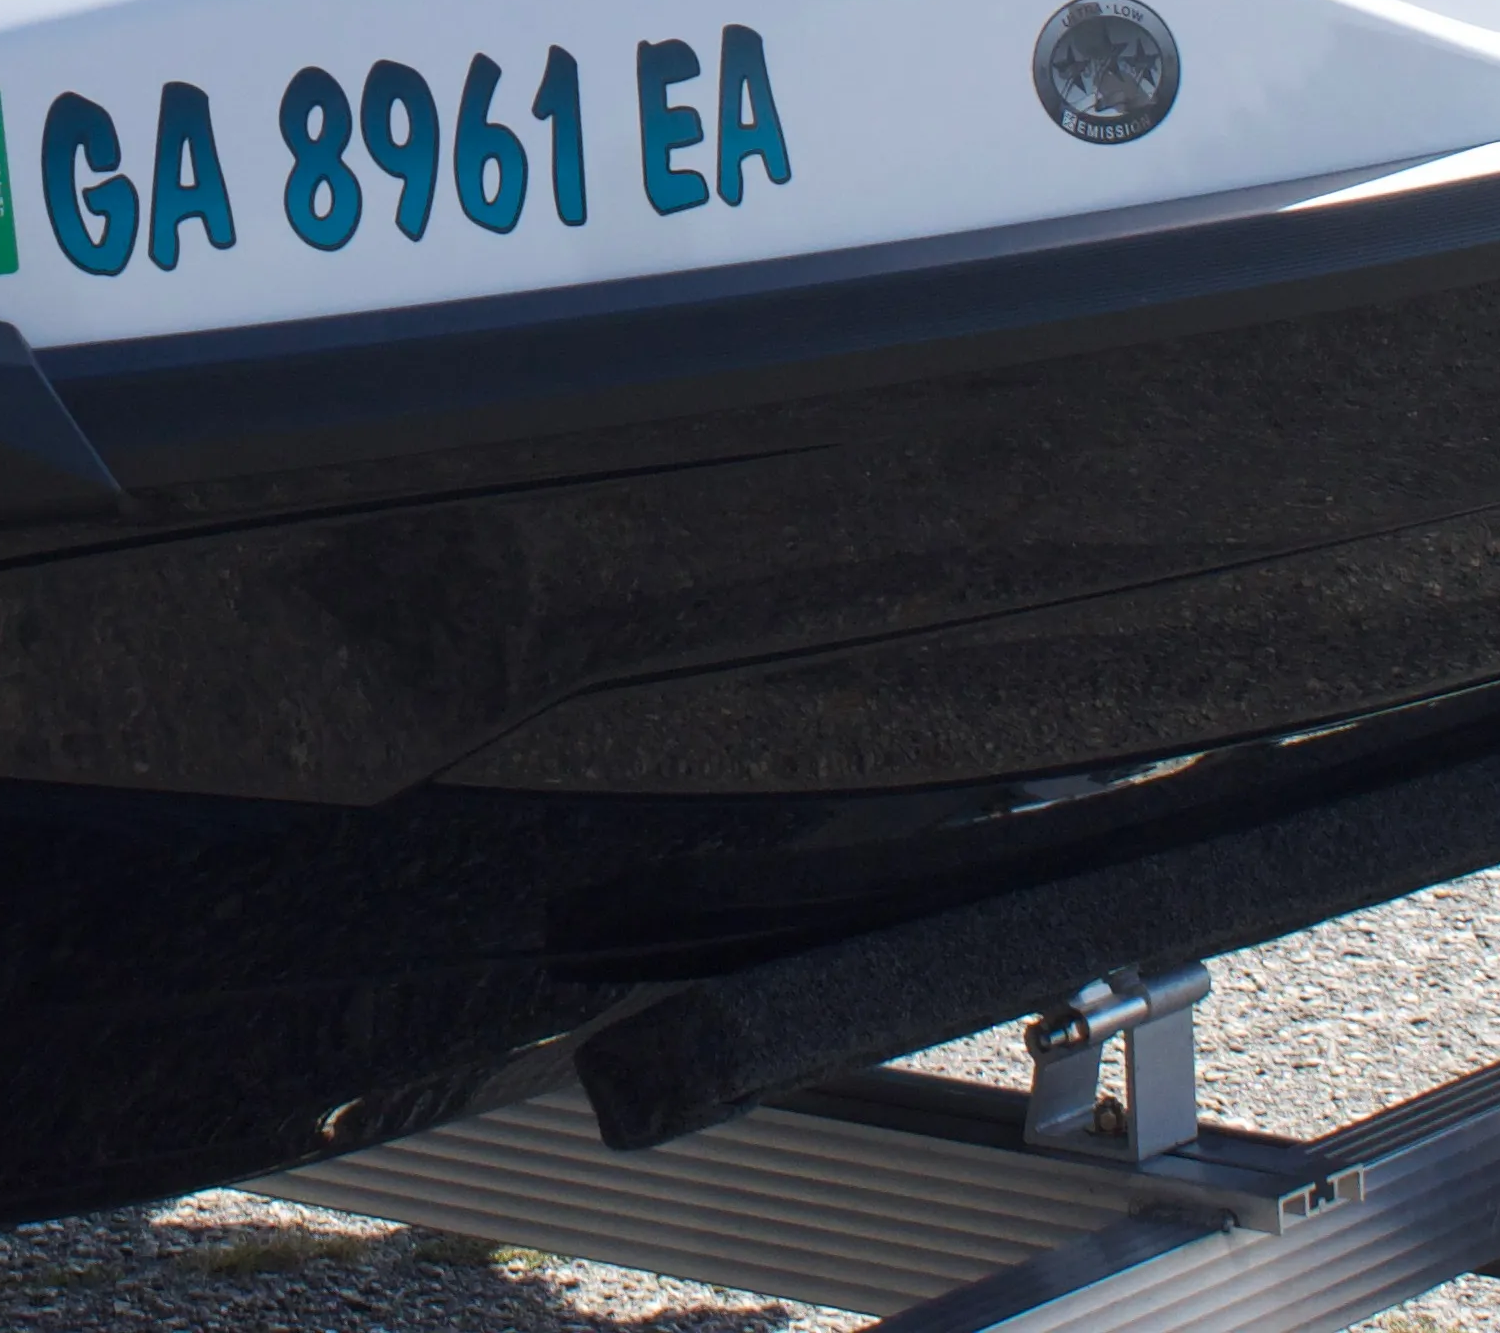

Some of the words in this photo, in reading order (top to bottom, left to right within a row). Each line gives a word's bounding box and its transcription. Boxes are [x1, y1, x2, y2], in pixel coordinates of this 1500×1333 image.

[41, 81, 237, 279] GA
[279, 44, 588, 253] 8961
[637, 24, 792, 217] EA
